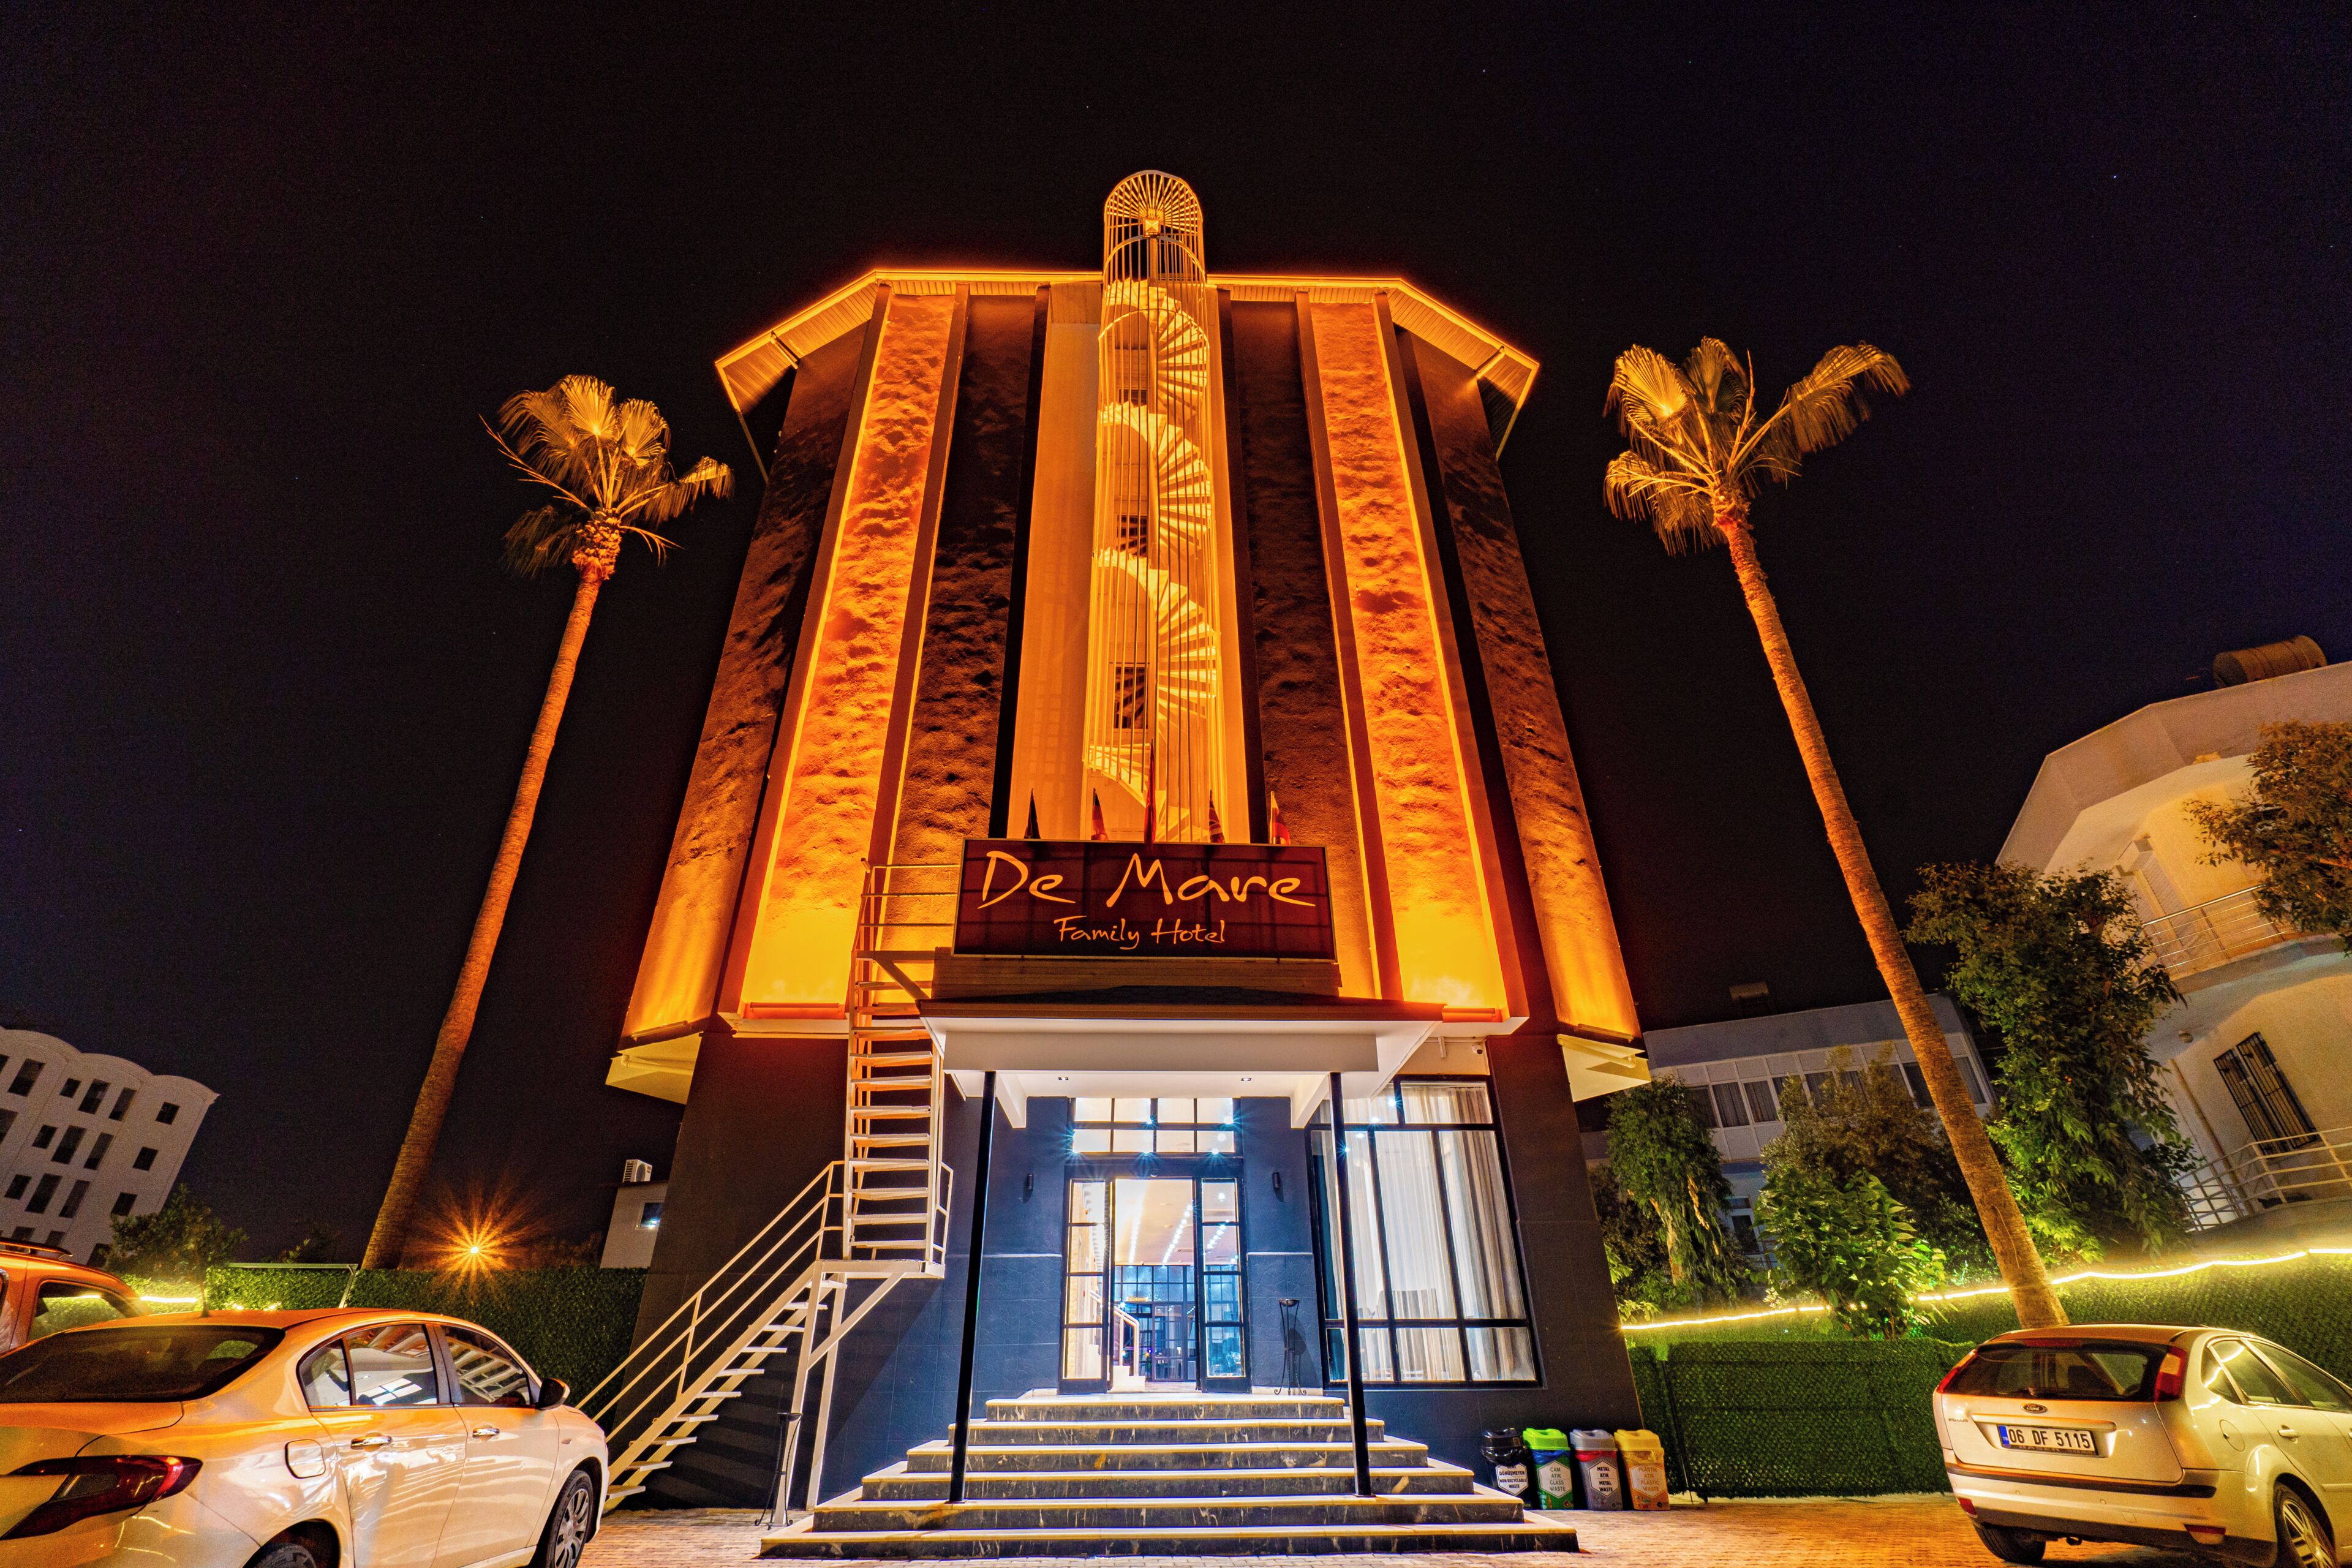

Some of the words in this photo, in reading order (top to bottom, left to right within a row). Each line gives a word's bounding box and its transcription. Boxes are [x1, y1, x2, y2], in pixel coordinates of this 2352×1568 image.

[977, 850, 1076, 909] De
[1106, 853, 1316, 907] Mare
[1054, 915, 1140, 949] Family
[1151, 918, 1225, 944] Hotel
[2008, 1429, 2024, 1444] 06
[2032, 1430, 2048, 1445] DF
[2054, 1431, 2090, 1449] 5115
